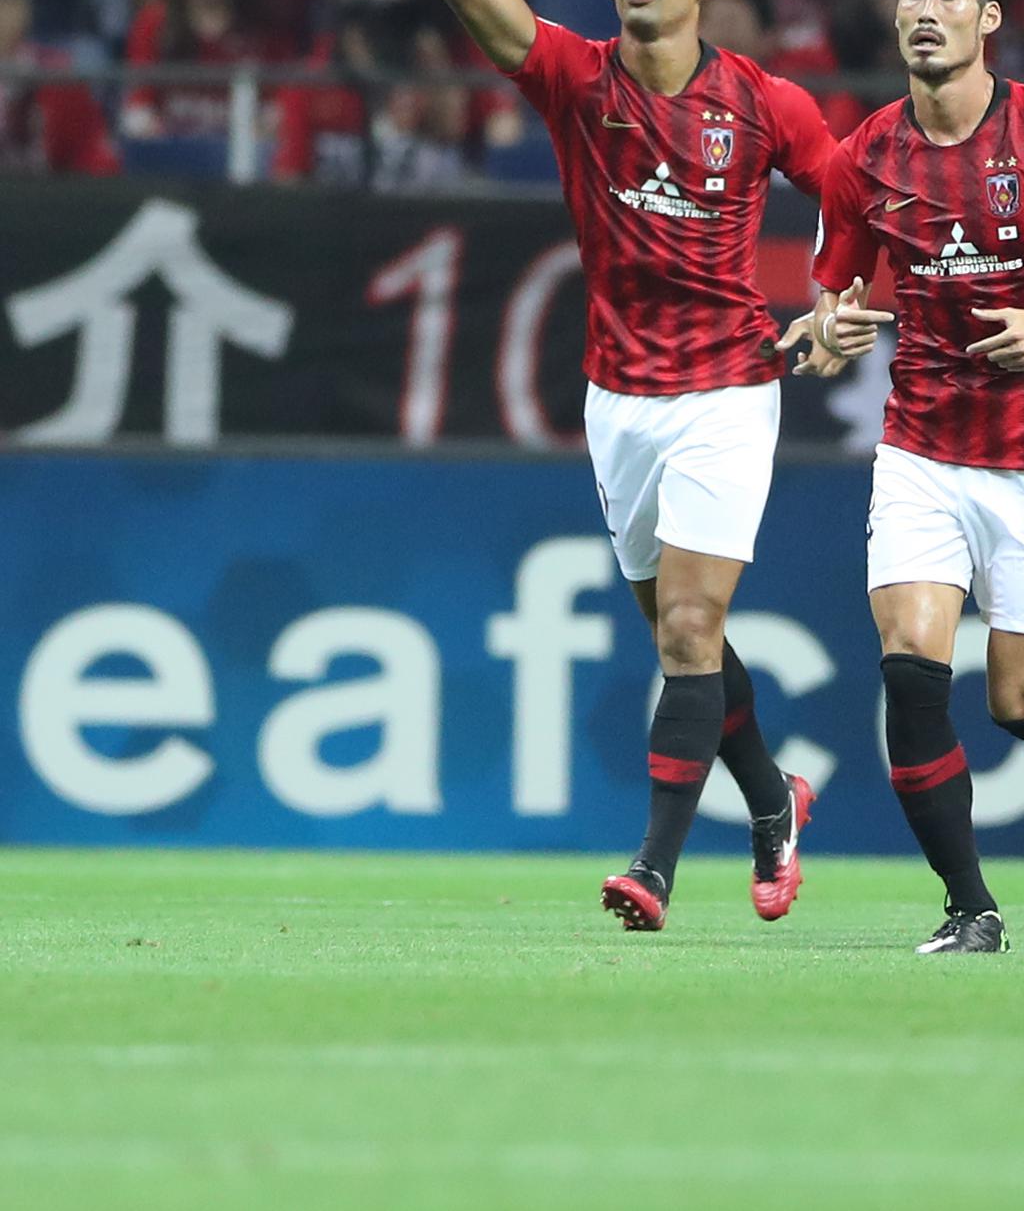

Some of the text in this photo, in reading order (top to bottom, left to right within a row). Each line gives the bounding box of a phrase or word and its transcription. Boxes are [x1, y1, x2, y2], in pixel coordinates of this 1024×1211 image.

[624, 188, 697, 210] MITSUBISHI
[910, 258, 1023, 277] HEAVY INDUSTRIES
